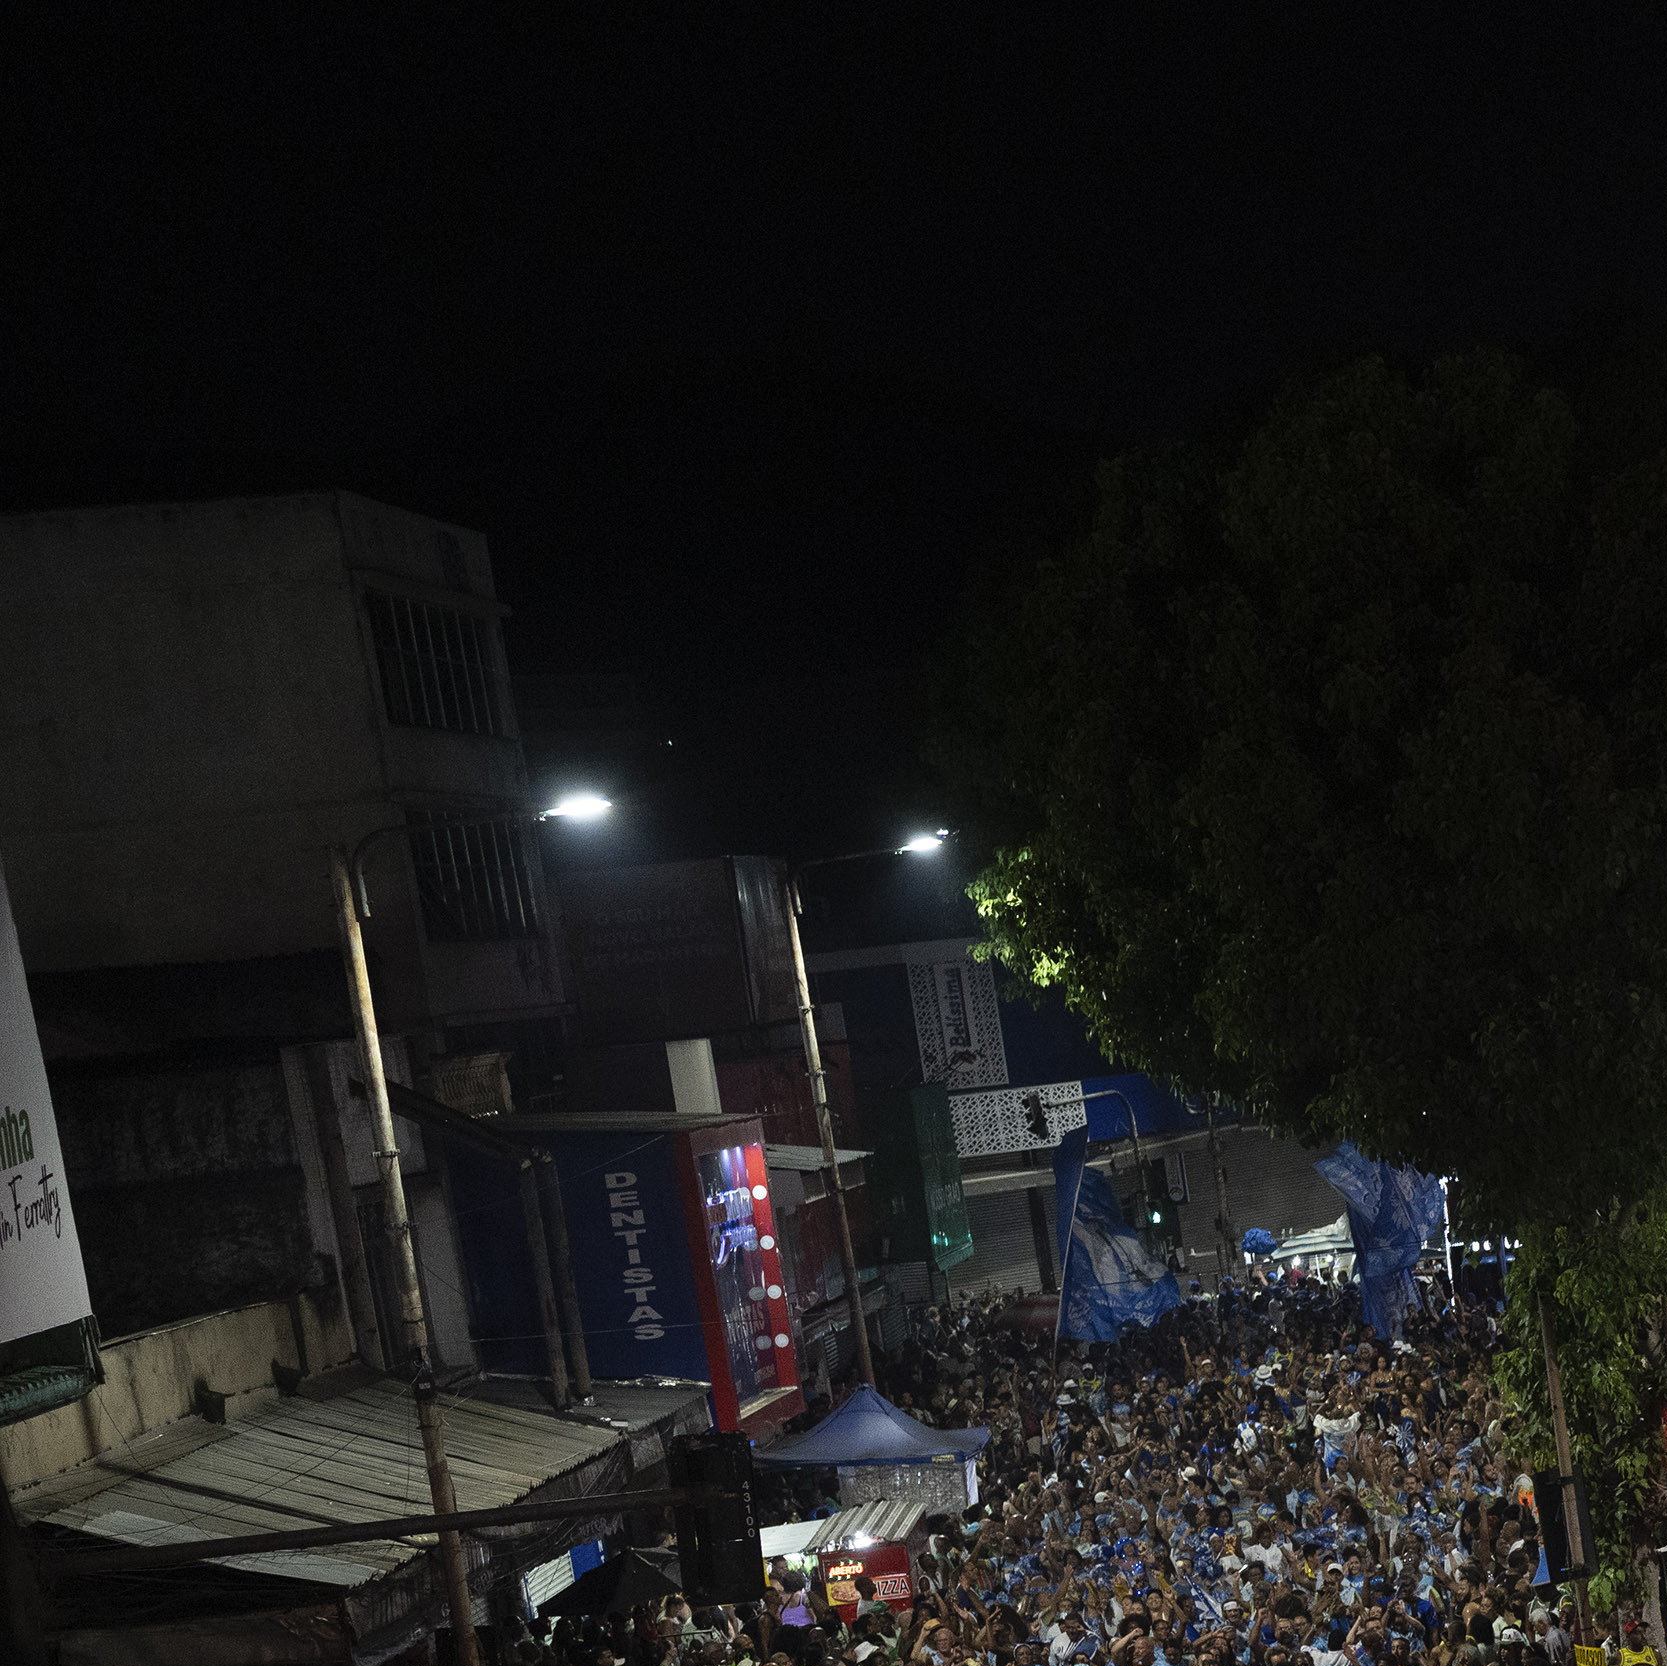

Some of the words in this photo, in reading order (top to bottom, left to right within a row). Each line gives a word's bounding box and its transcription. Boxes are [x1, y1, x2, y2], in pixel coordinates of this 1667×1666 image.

[604, 1171, 665, 1340] DENTISTAS
[741, 1480, 756, 1538] 43100
[828, 1564, 864, 1577] ABERTO
[876, 1577, 911, 1597] IZZA
